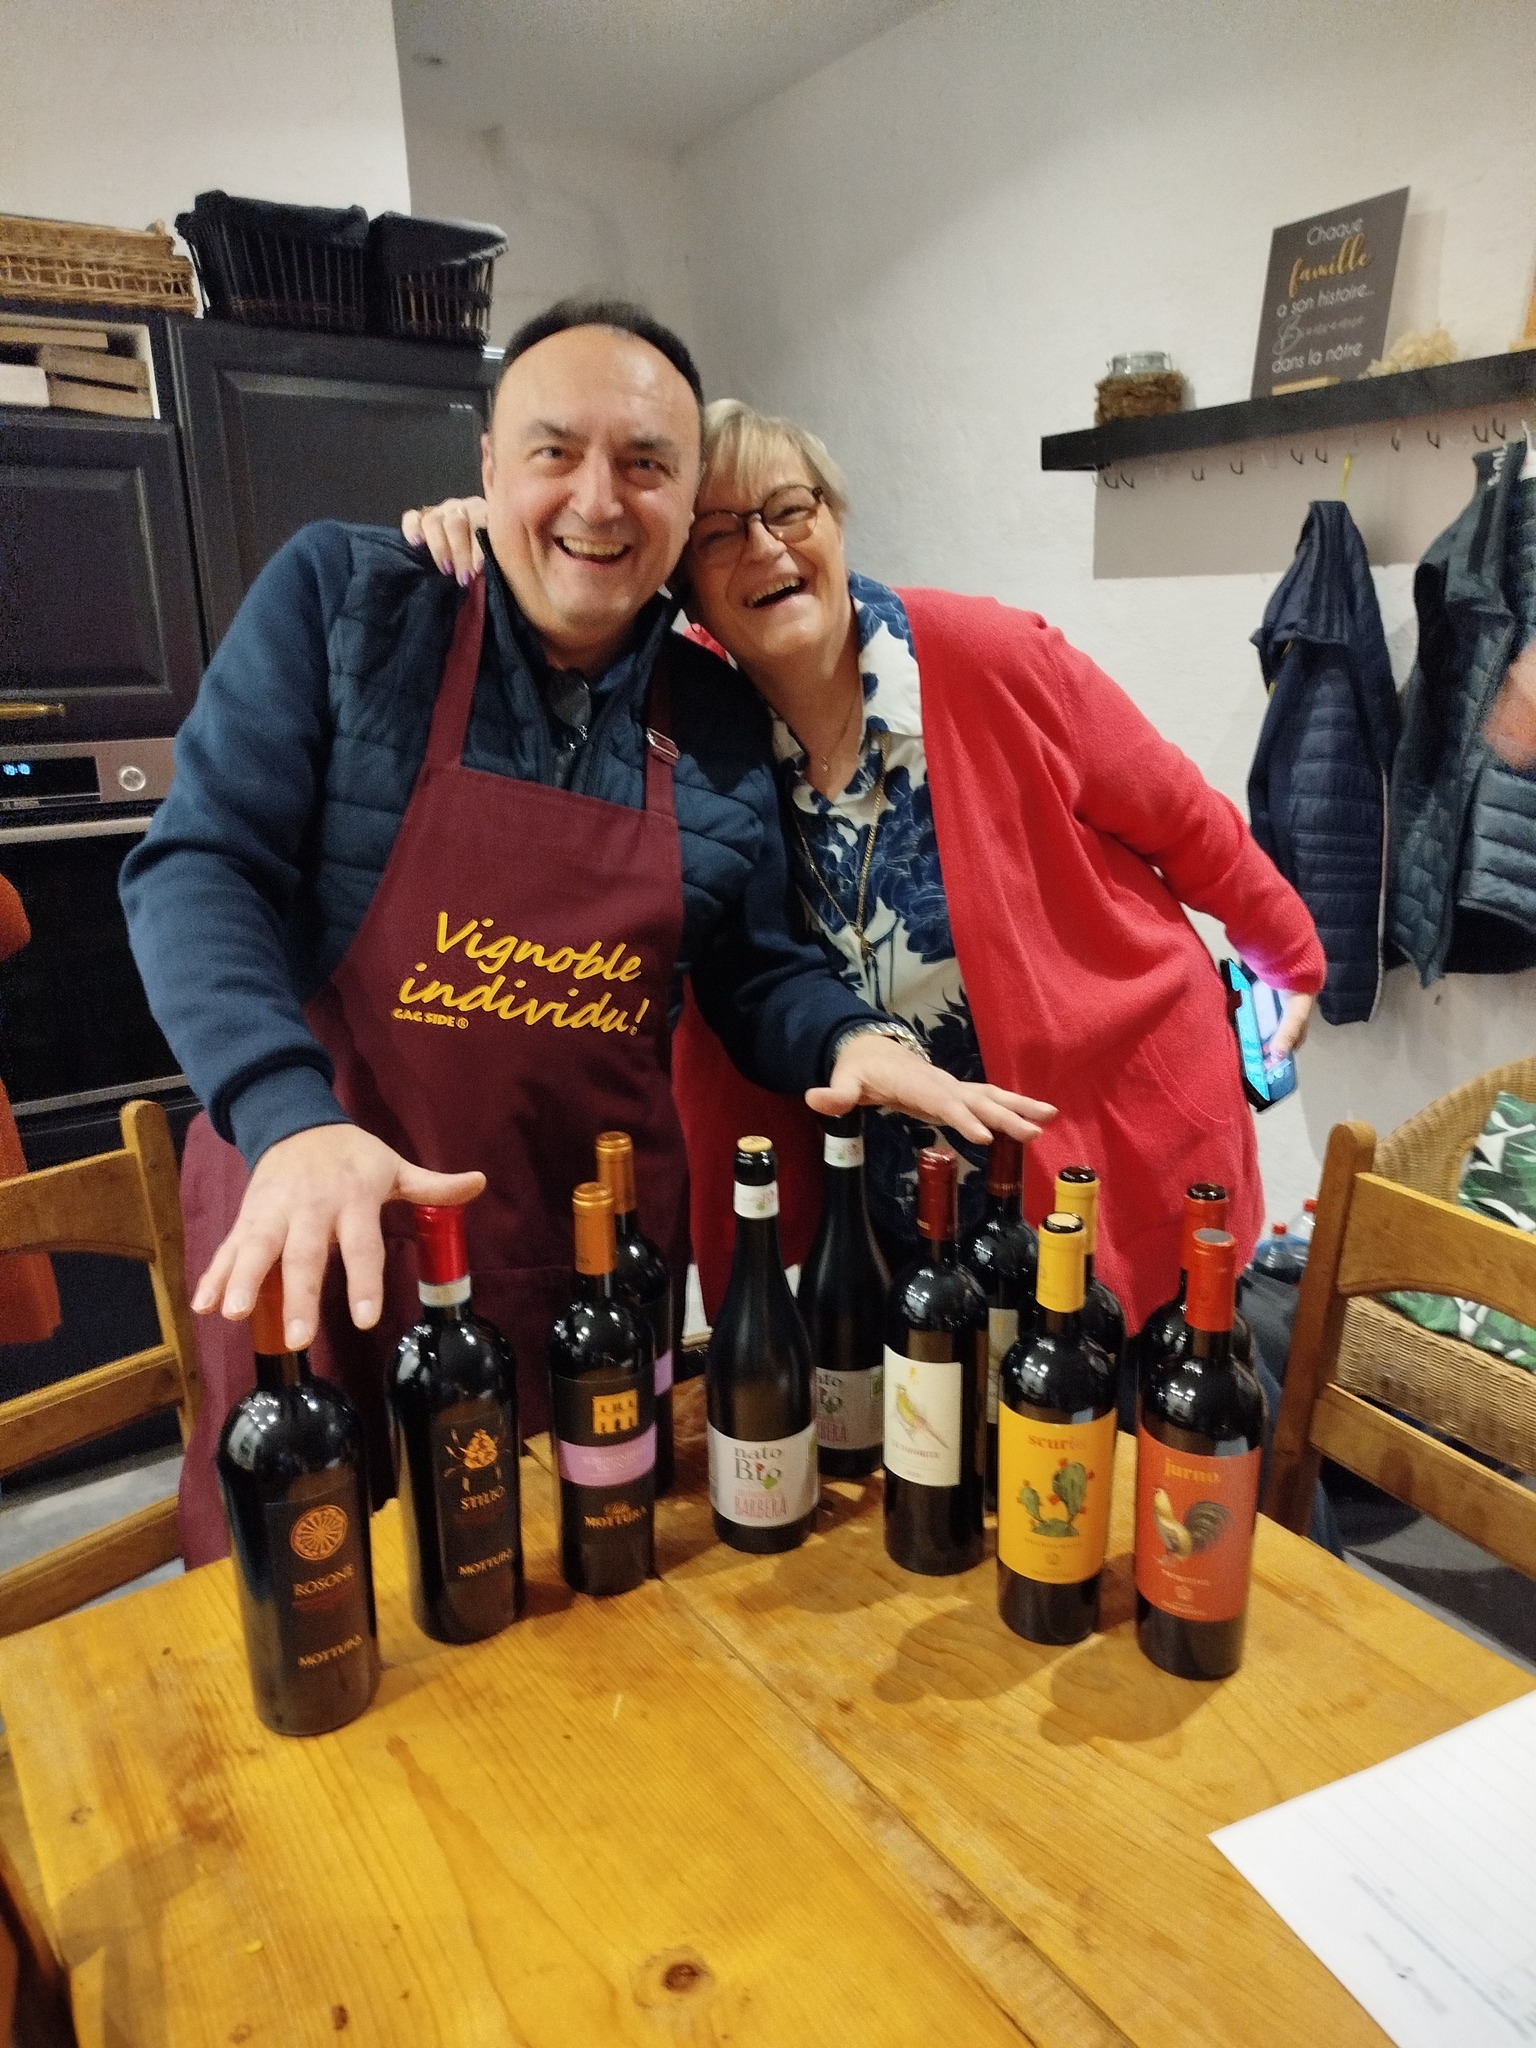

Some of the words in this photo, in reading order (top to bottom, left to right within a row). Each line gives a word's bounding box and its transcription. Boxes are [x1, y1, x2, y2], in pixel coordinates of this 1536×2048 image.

[1287, 231, 1371, 299] famille
[1290, 297, 1315, 316] son
[1271, 353, 1305, 375] dans
[1307, 347, 1324, 368] la
[436, 911, 643, 983] Vignoble
[398, 961, 650, 1036] individu!
[734, 1446, 784, 1460] nato
[733, 1456, 784, 1482] Bio
[734, 1494, 787, 1519] BARBERA
